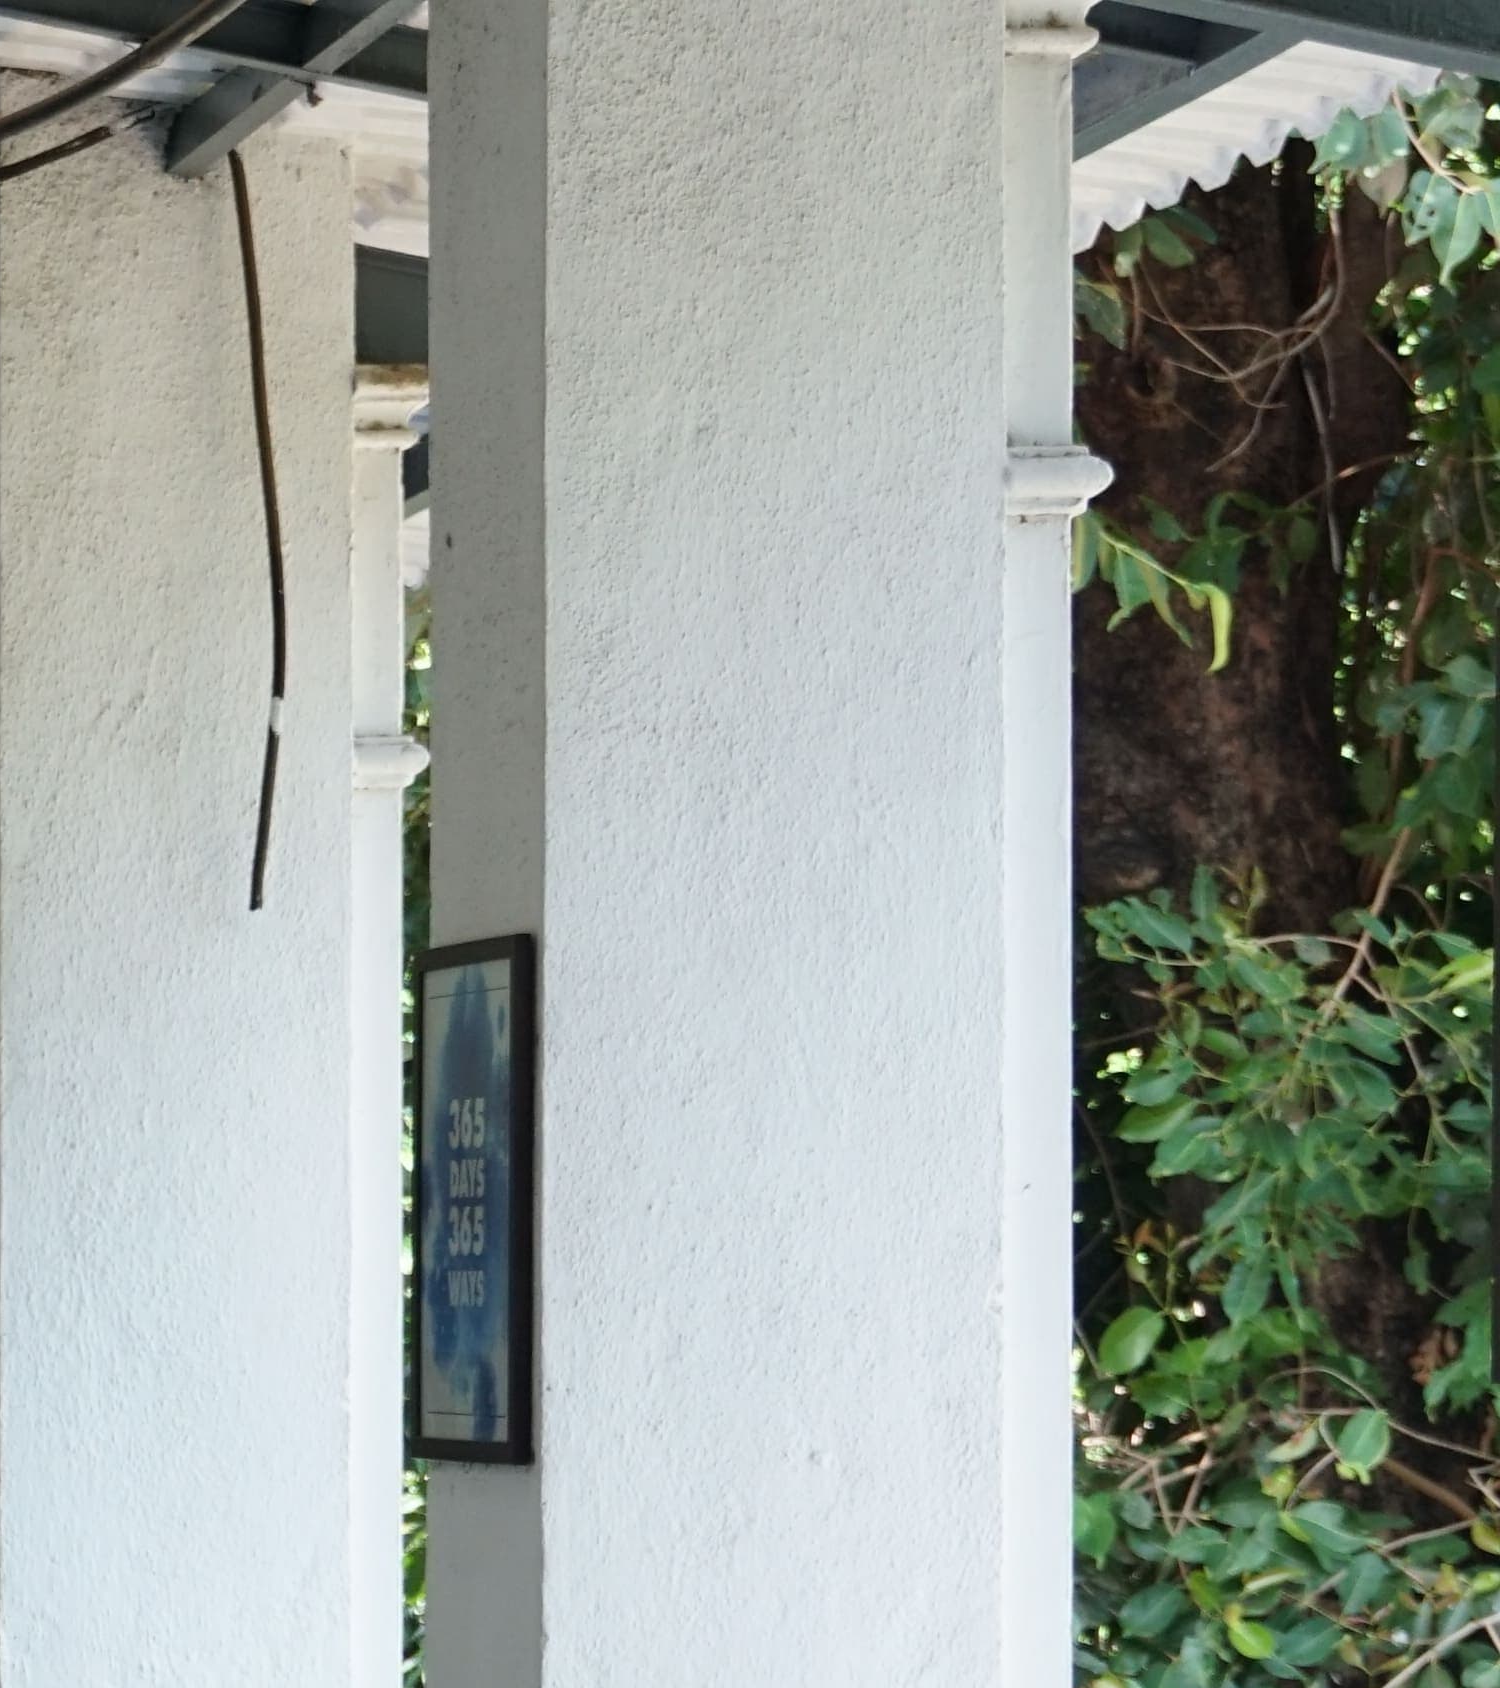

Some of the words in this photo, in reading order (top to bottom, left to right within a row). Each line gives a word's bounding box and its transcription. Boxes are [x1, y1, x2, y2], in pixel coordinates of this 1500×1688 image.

[448, 1097, 485, 1150] 365
[449, 1159, 485, 1199] DAYS
[448, 1206, 485, 1257] 365
[447, 1270, 485, 1308] WAYS
